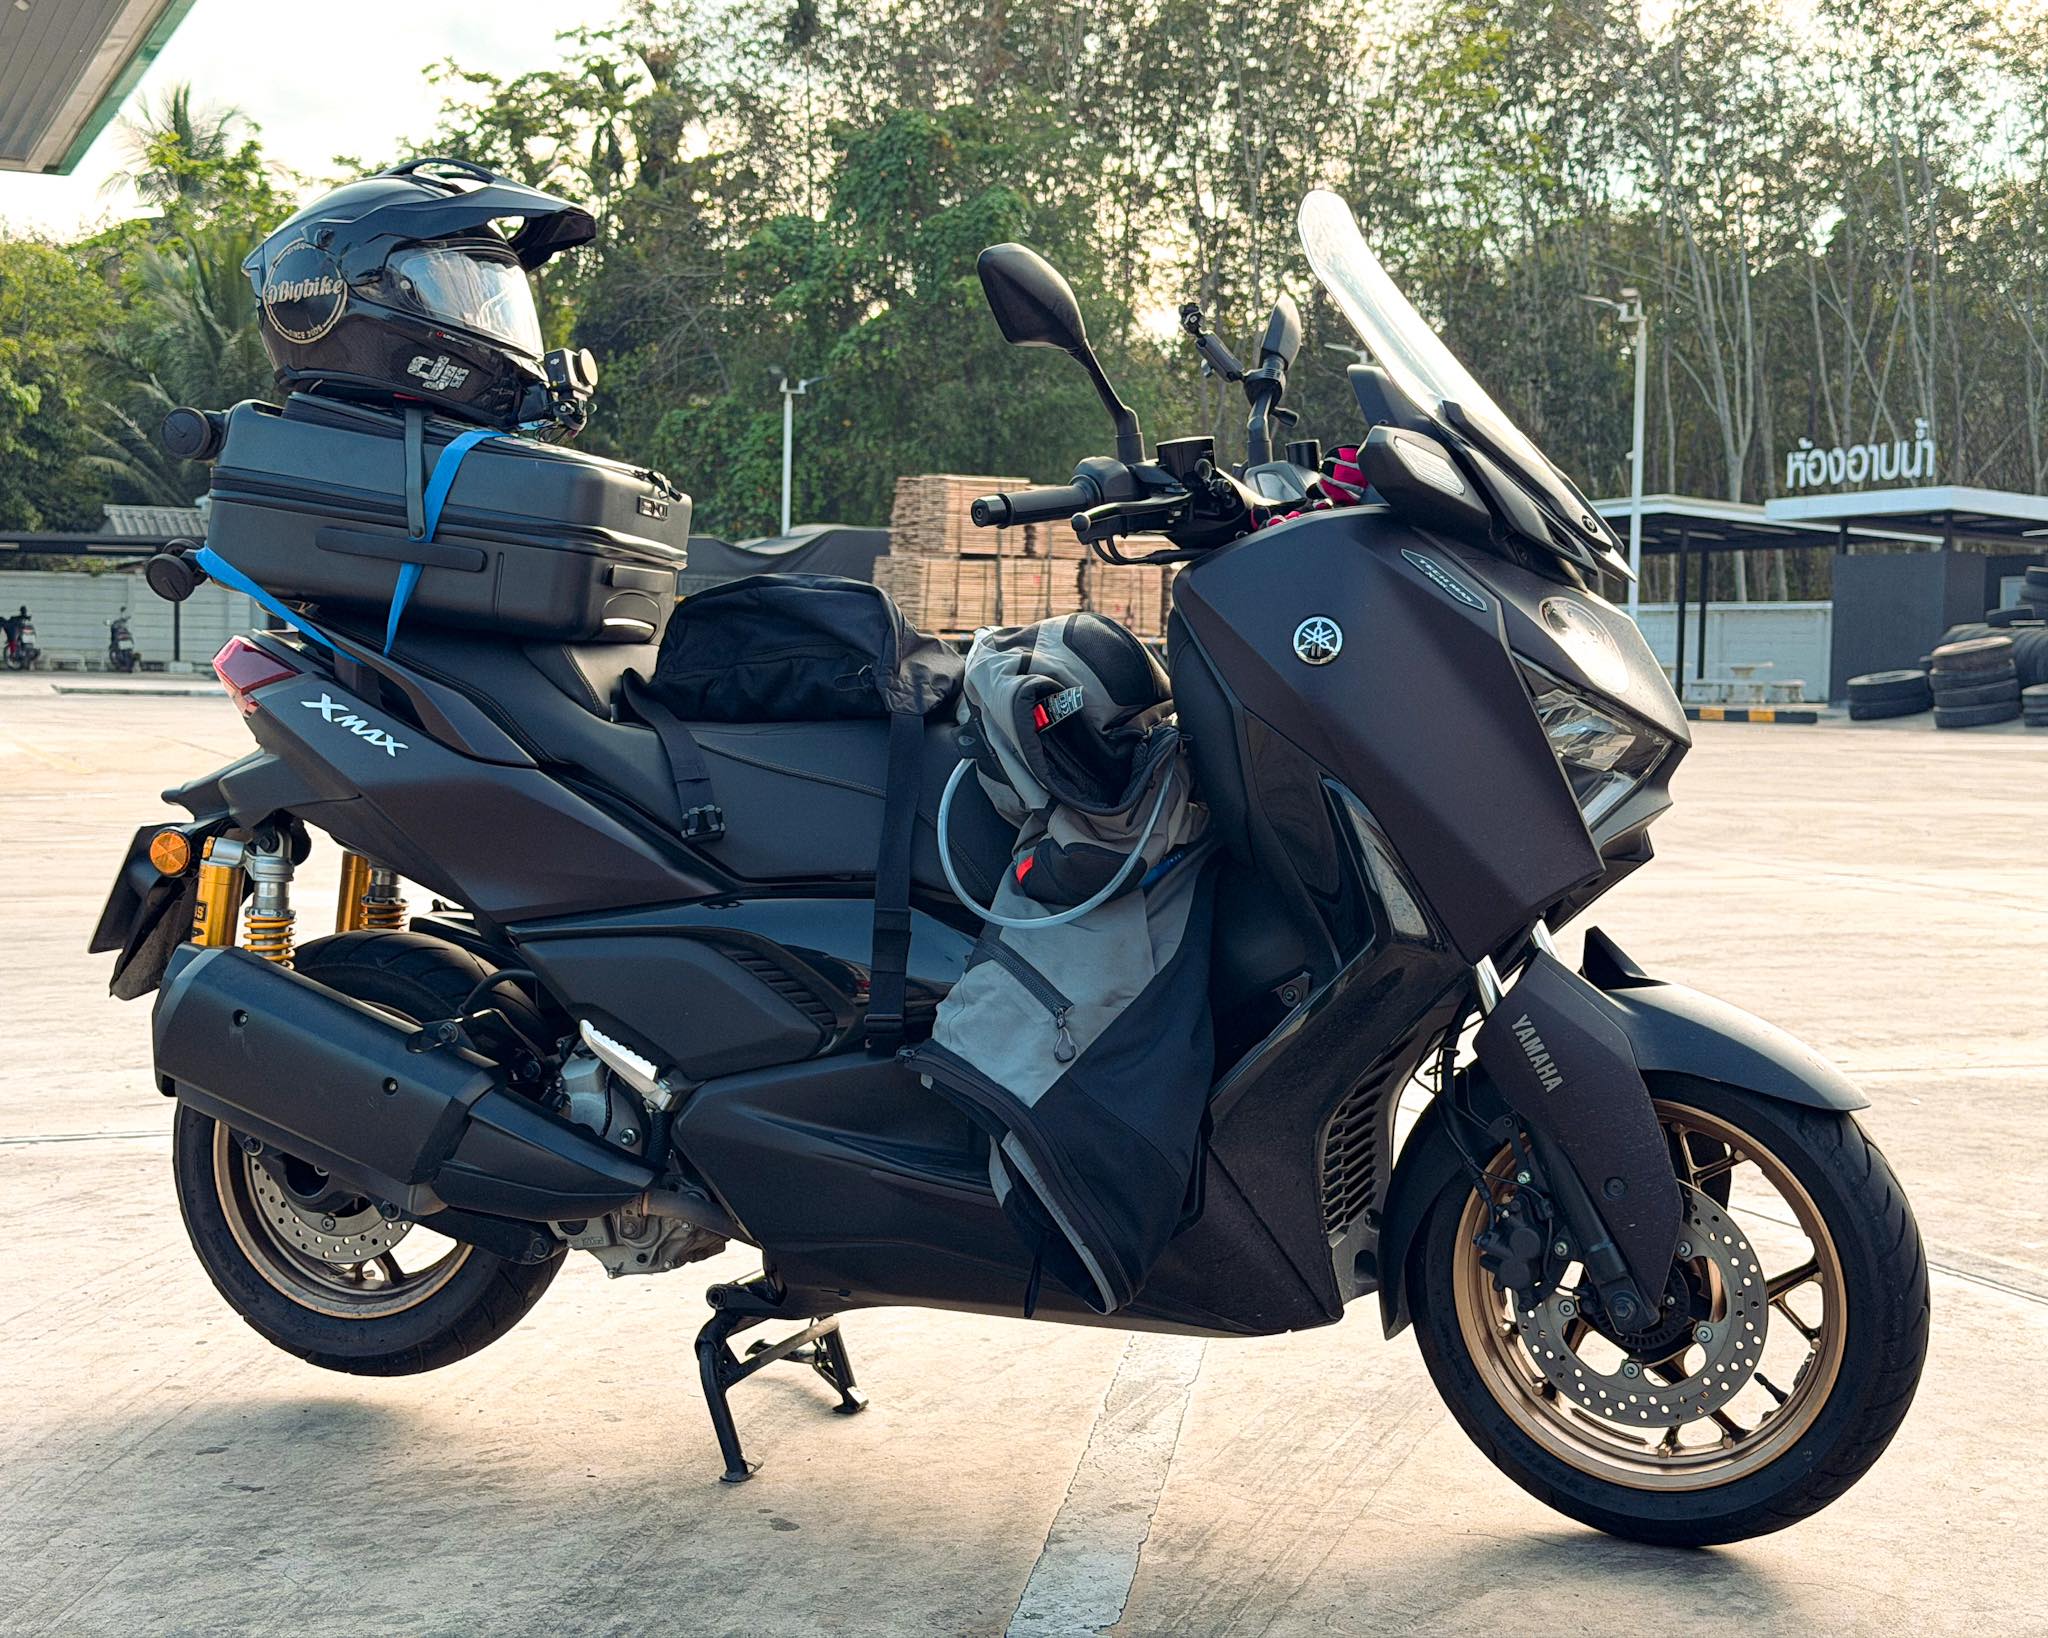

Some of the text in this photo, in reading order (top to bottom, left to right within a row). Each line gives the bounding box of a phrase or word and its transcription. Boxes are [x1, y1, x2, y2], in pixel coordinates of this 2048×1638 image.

[1786, 417, 1936, 489] ห้องอาบน้ำ
[300, 692, 409, 758] XMAX
[1511, 1013, 1564, 1093] YAMAHA
